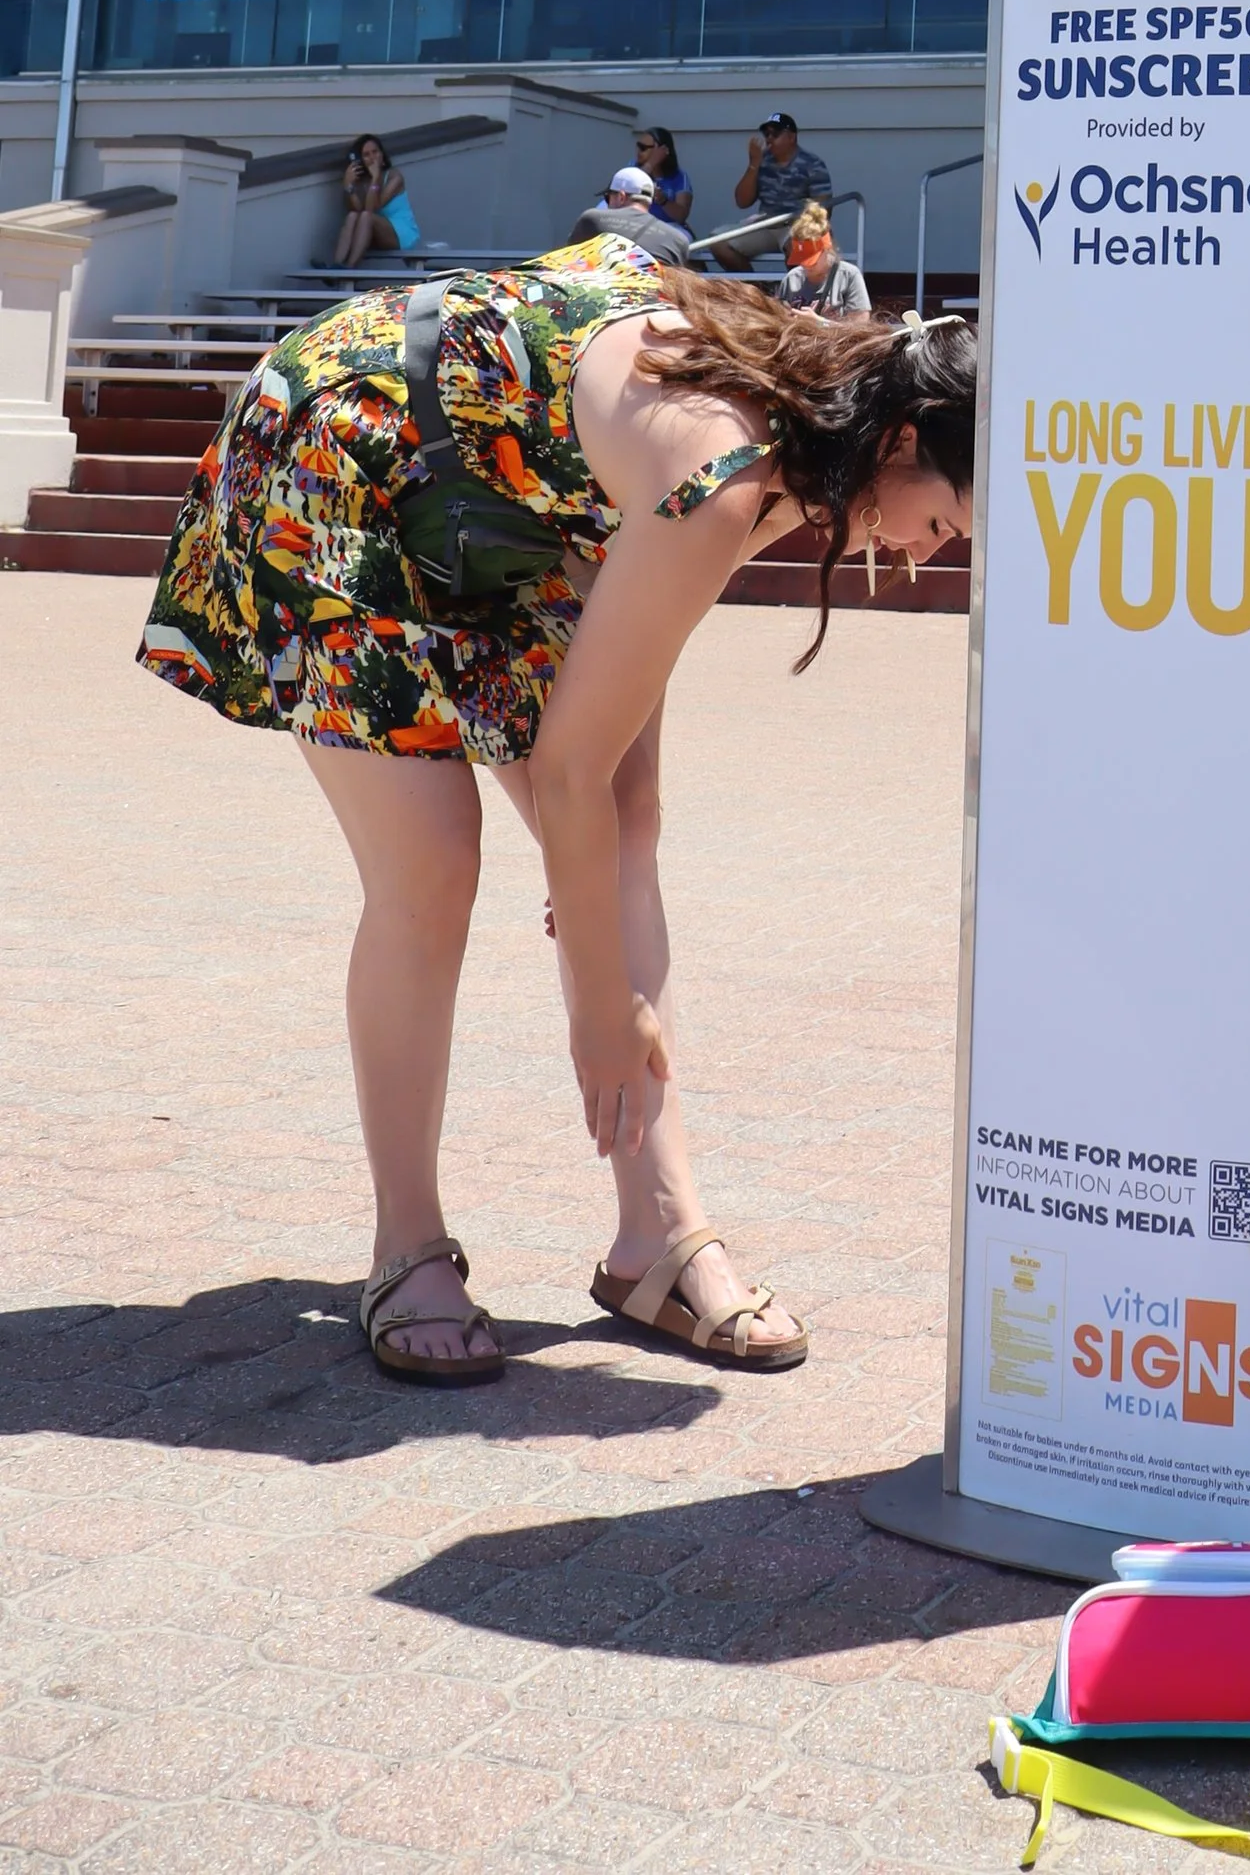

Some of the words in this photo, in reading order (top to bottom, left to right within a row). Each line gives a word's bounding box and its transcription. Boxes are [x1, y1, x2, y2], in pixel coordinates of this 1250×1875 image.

[1050, 8, 1137, 44] FREE
[1087, 117, 1173, 138] Provided
[1180, 117, 1206, 142] by
[1073, 226, 1221, 266] Health
[1024, 399, 1144, 467] LONG
[977, 1125, 1033, 1155] SCAN
[1038, 1137, 1069, 1161] ME
[1075, 1143, 1122, 1169] FOR
[1127, 1151, 1198, 1178] MORE
[976, 1154, 1112, 1196] INFORMATION
[1118, 1180, 1197, 1206] ABOUT
[975, 1183, 1036, 1214] VITAL
[1040, 1196, 1109, 1226] SIGNS
[1115, 1208, 1196, 1238] MEDIA
[1103, 1286, 1179, 1329] vital
[1105, 1391, 1178, 1422] MEDIA
[976, 1432, 1002, 1448] broken
[1002, 1441, 1012, 1450] or
[1012, 1442, 1049, 1460] damaged
[1050, 1451, 1069, 1465] skin.
[1076, 1455, 1115, 1474] irritation
[1116, 1465, 1147, 1480] occurs,
[1148, 1470, 1171, 1483] rinse
[1172, 1473, 1223, 1492] thoroughly
[1223, 1480, 1245, 1492] with
[977, 1420, 992, 1433] Not
[993, 1424, 1023, 1440] suitable
[1024, 1430, 1036, 1443] for
[1036, 1433, 1063, 1450] babies
[1063, 1441, 1089, 1454] under
[1095, 1447, 1129, 1462] months
[1130, 1453, 1146, 1465] old.
[1148, 1455, 1173, 1469] Avoid
[1174, 1460, 1210, 1475] contact
[1211, 1464, 1233, 1477] with
[987, 1449, 1033, 1471] Discontinue
[1033, 1463, 1048, 1474] use
[1048, 1464, 1100, 1487] immediately
[1100, 1477, 1118, 1488] and
[1119, 1479, 1139, 1492] seek
[1140, 1483, 1176, 1498] medical
[1177, 1489, 1207, 1503] advice
[1208, 1492, 1217, 1503] if
